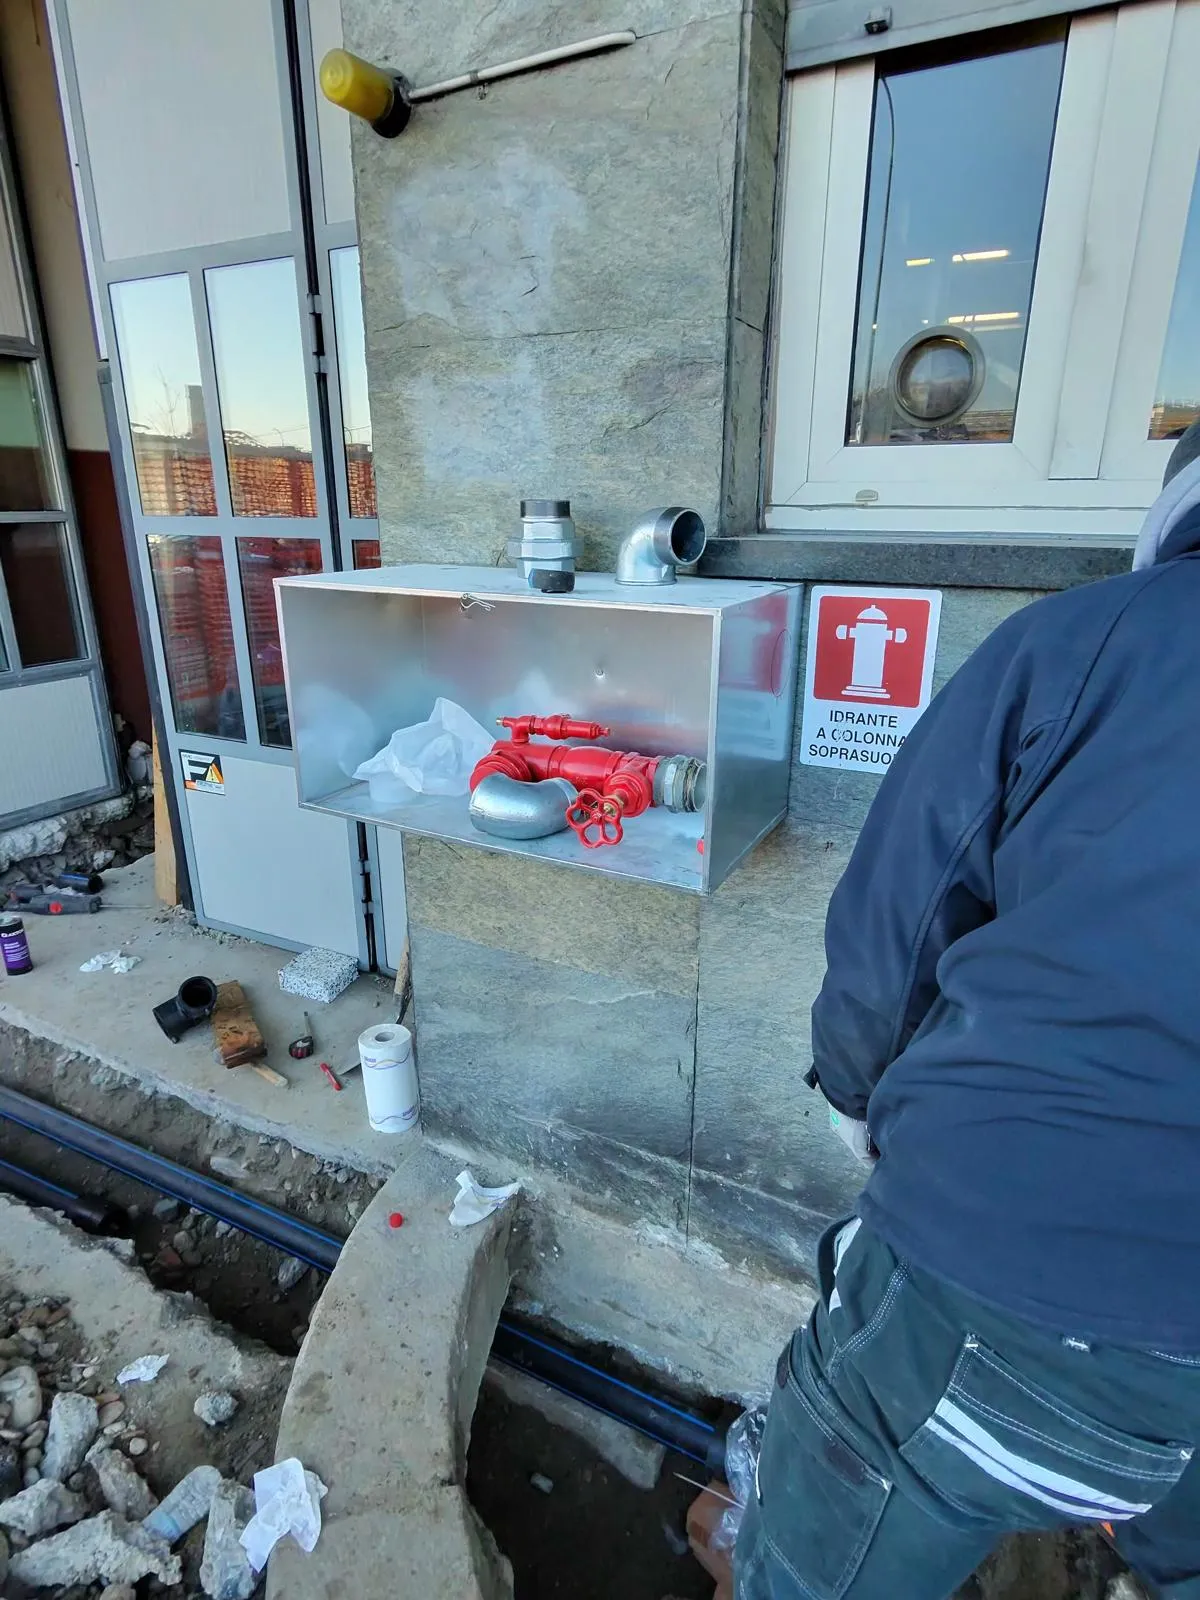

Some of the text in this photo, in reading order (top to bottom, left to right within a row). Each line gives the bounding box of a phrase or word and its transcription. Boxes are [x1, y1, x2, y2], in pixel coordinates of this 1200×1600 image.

[830, 710, 898, 728] IDRANTE
[816, 727, 826, 739] A
[808, 744, 896, 765] SOPRASUO
